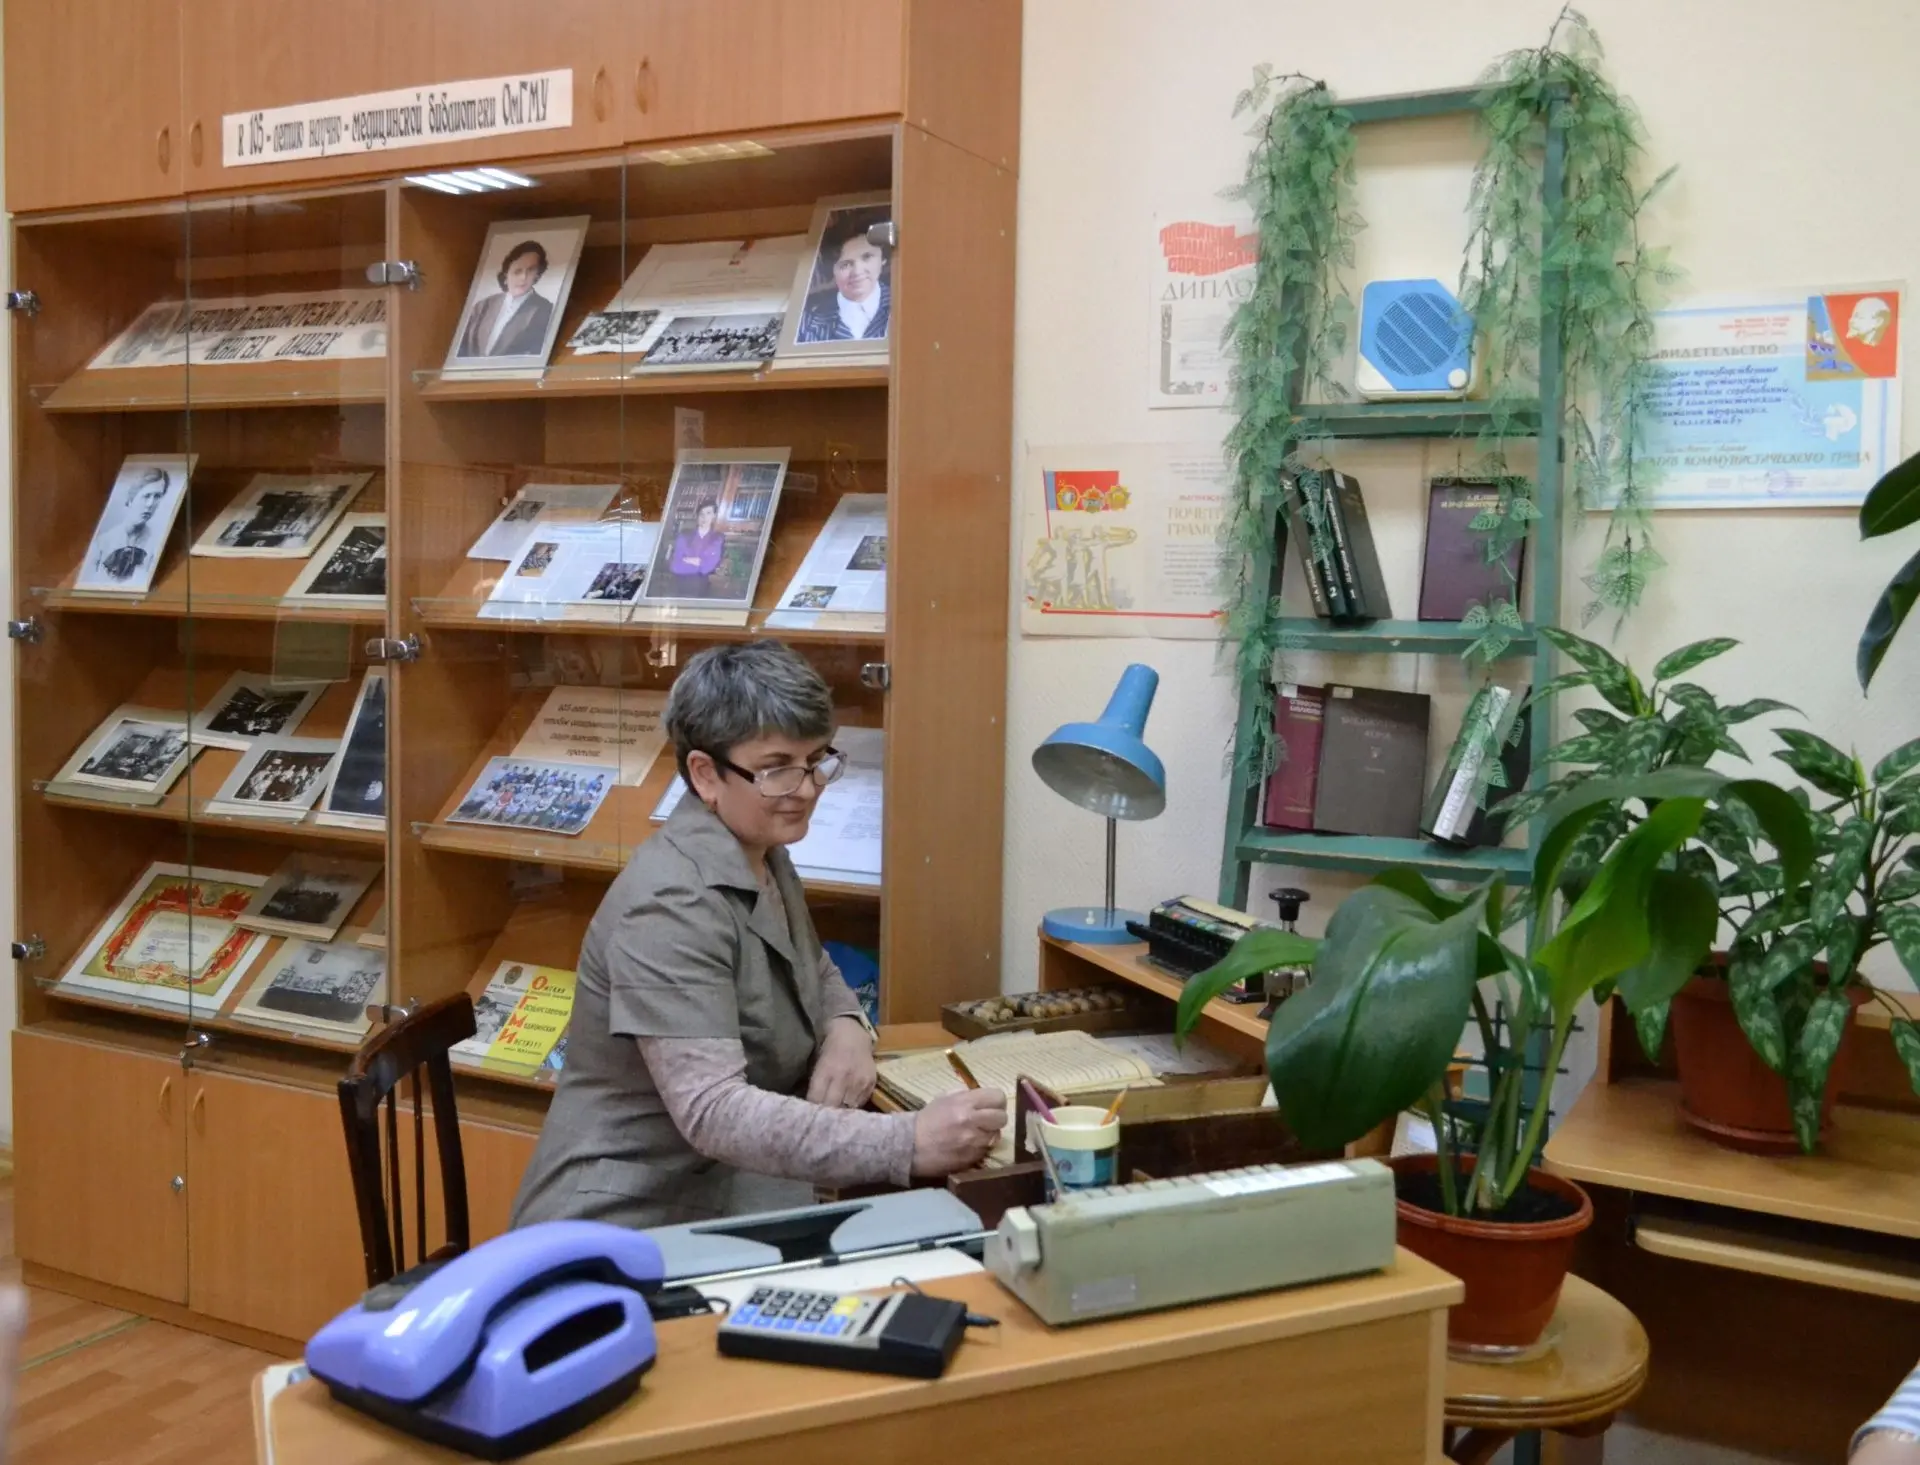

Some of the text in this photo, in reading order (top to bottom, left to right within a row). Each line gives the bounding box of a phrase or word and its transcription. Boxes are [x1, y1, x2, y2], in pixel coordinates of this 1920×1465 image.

[429, 92, 496, 134] библиотеки
[502, 78, 549, 126] ОмГМУ
[1160, 279, 1254, 301] ДИПЛО
[1658, 344, 1779, 360] ВИДЕТЕЛЬСТВО
[1167, 506, 1222, 521] ПОЧЕТ
[1167, 522, 1217, 537] ГРАМО
[1329, 586, 1338, 599] 2
[1349, 589, 1357, 600] 1
